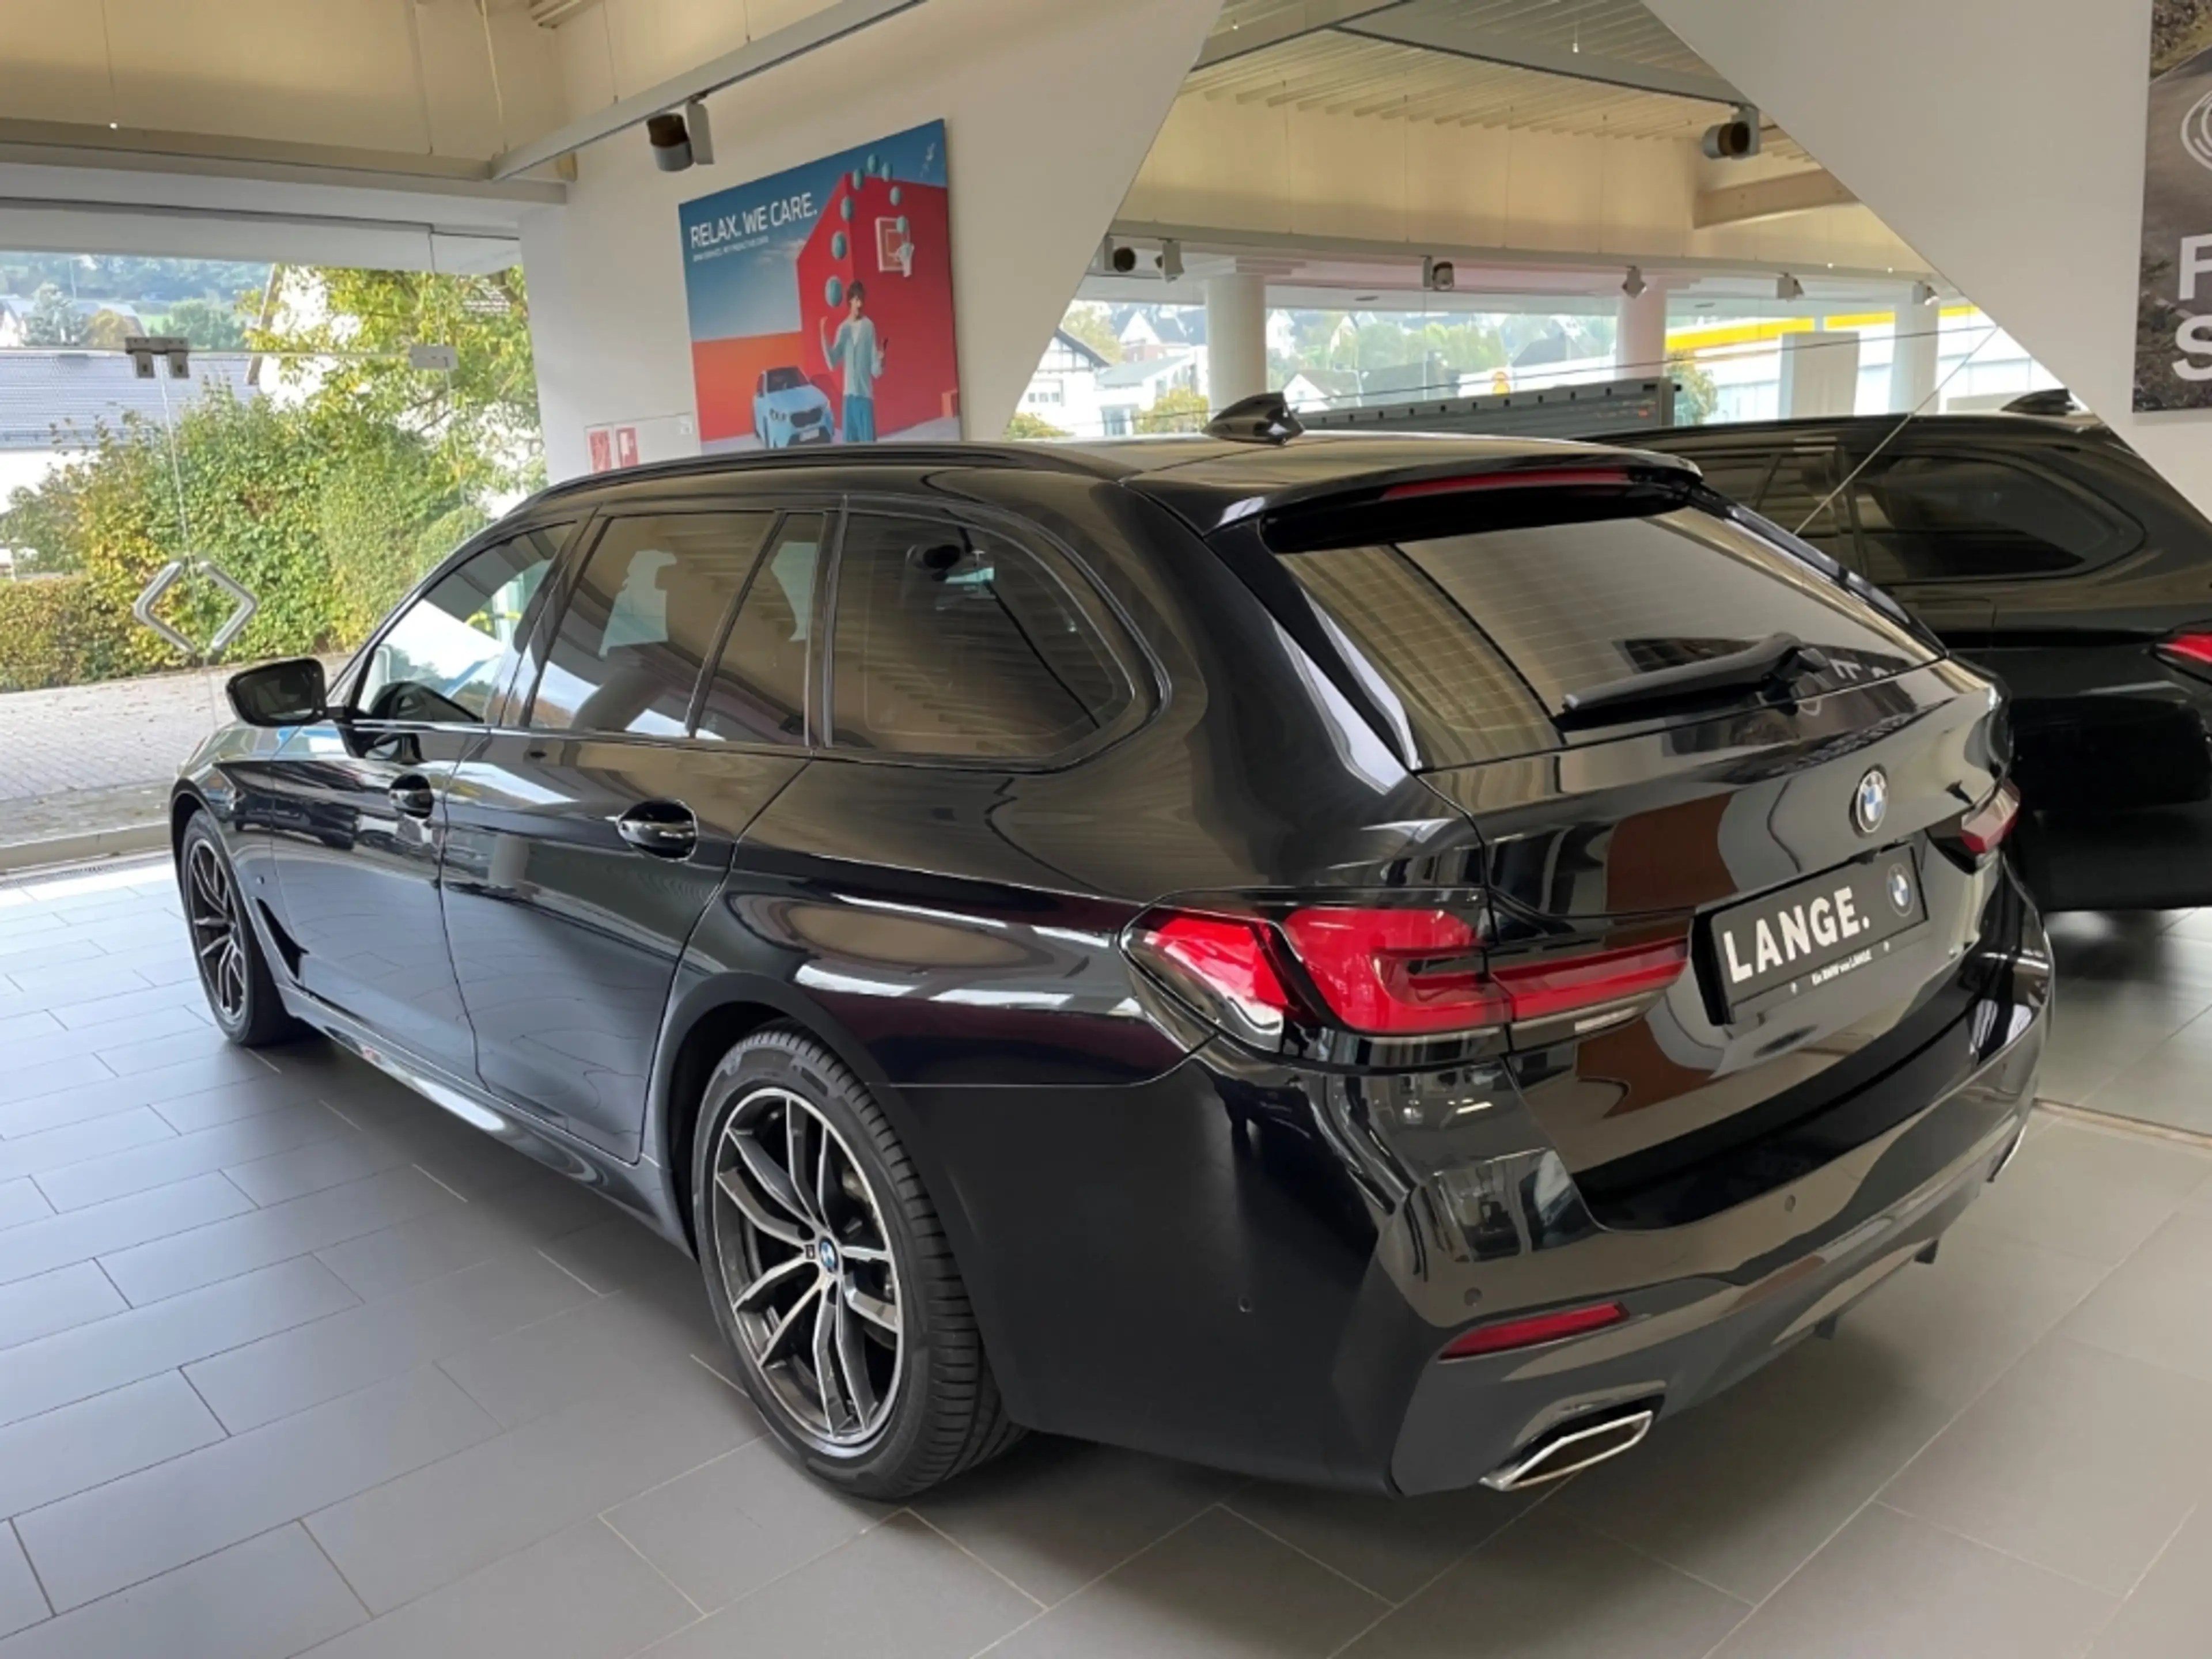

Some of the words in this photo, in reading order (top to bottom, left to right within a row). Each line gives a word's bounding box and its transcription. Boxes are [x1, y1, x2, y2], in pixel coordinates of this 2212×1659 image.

[690, 214, 742, 249] RELAX.
[742, 205, 768, 234] WE
[770, 192, 818, 227] CARE.
[1723, 886, 1870, 983] LANGE.
